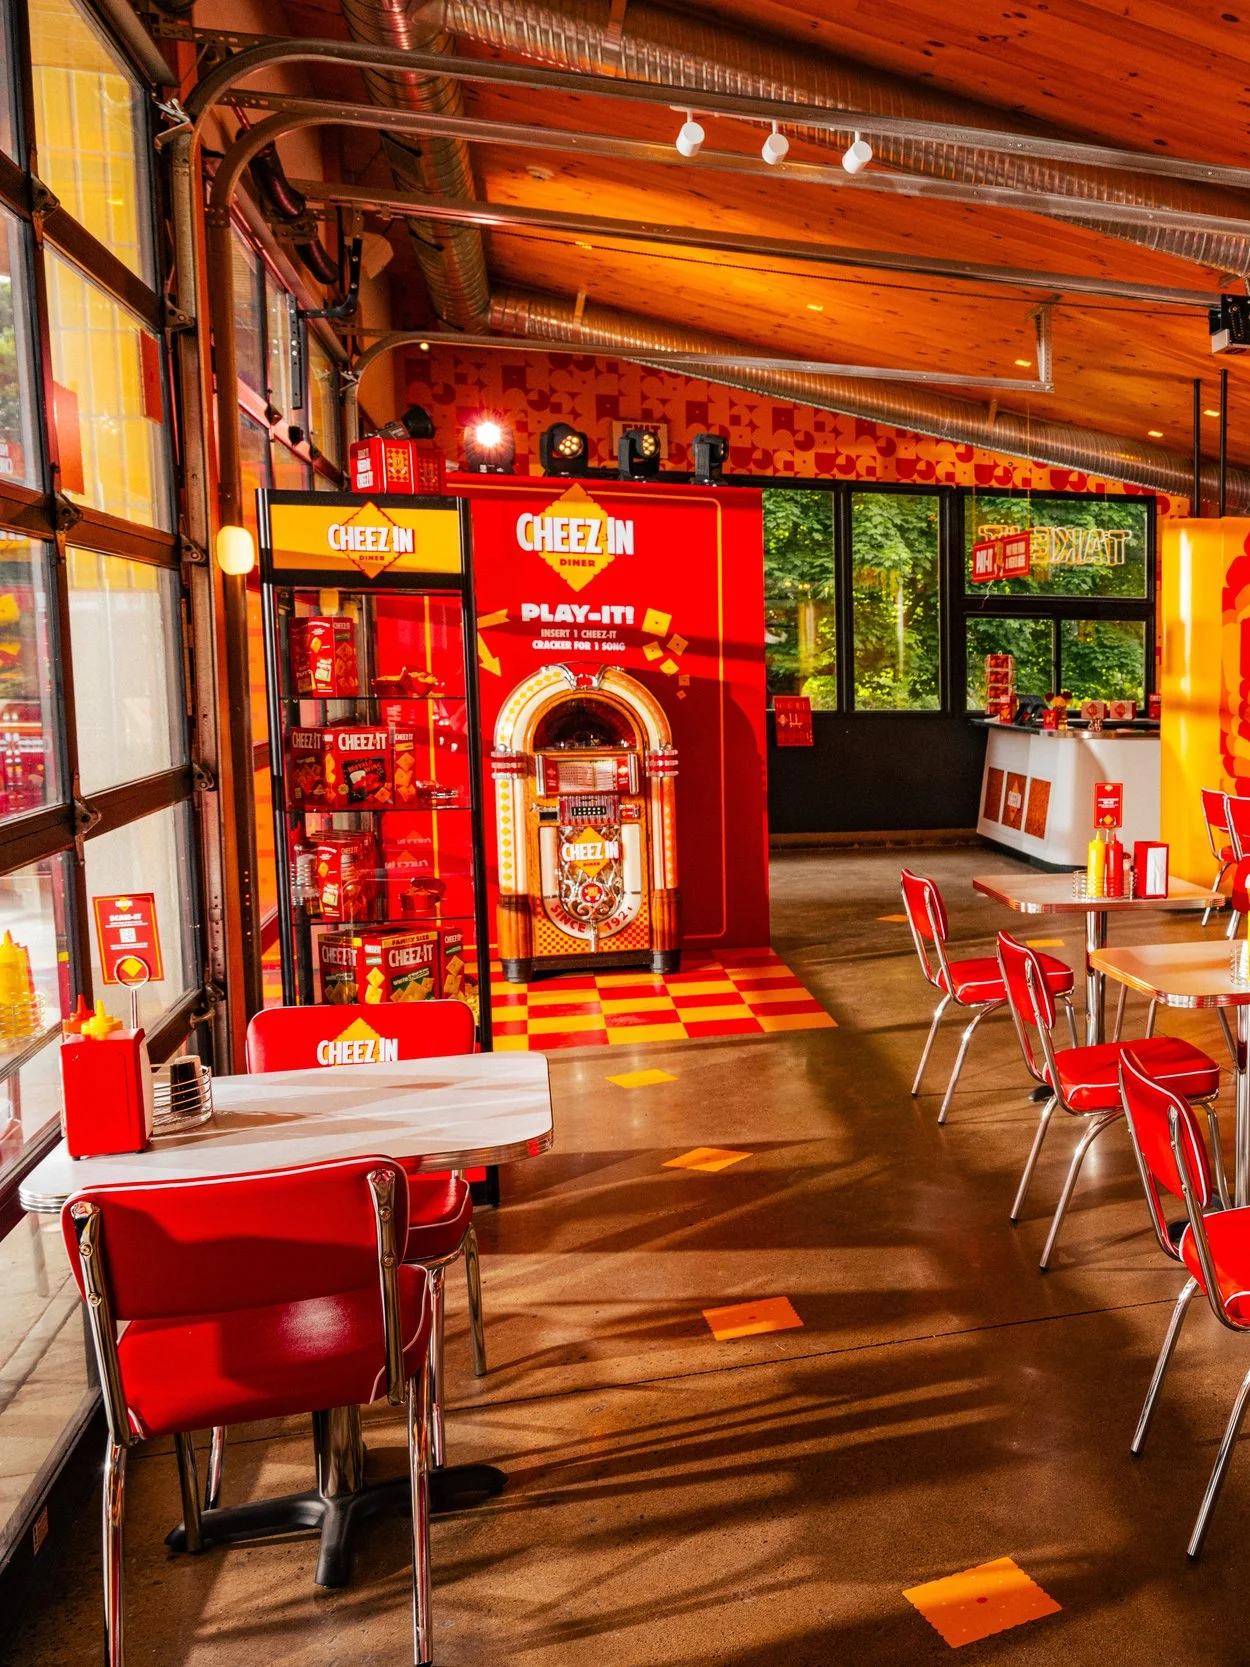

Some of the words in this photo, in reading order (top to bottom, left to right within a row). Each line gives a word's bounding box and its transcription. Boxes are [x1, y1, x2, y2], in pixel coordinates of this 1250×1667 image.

[328, 523, 390, 552] CHEEZ
[392, 525, 414, 553] IN
[516, 513, 602, 554] CHEEZ
[606, 516, 634, 555] IN
[559, 558, 596, 567] DINER
[521, 603, 635, 624] PLAY-IT!
[541, 629, 570, 638] INSERT
[581, 630, 617, 639] CHEEZ-IT
[532, 640, 572, 650] CRACKER
[573, 641, 591, 651] FOR
[601, 641, 626, 651] SONG
[561, 842, 603, 861] CHEEZ
[604, 840, 619, 859] IN
[550, 904, 587, 933] SINCE
[316, 1039, 376, 1065] CHEEZ
[378, 1036, 398, 1062] IN
